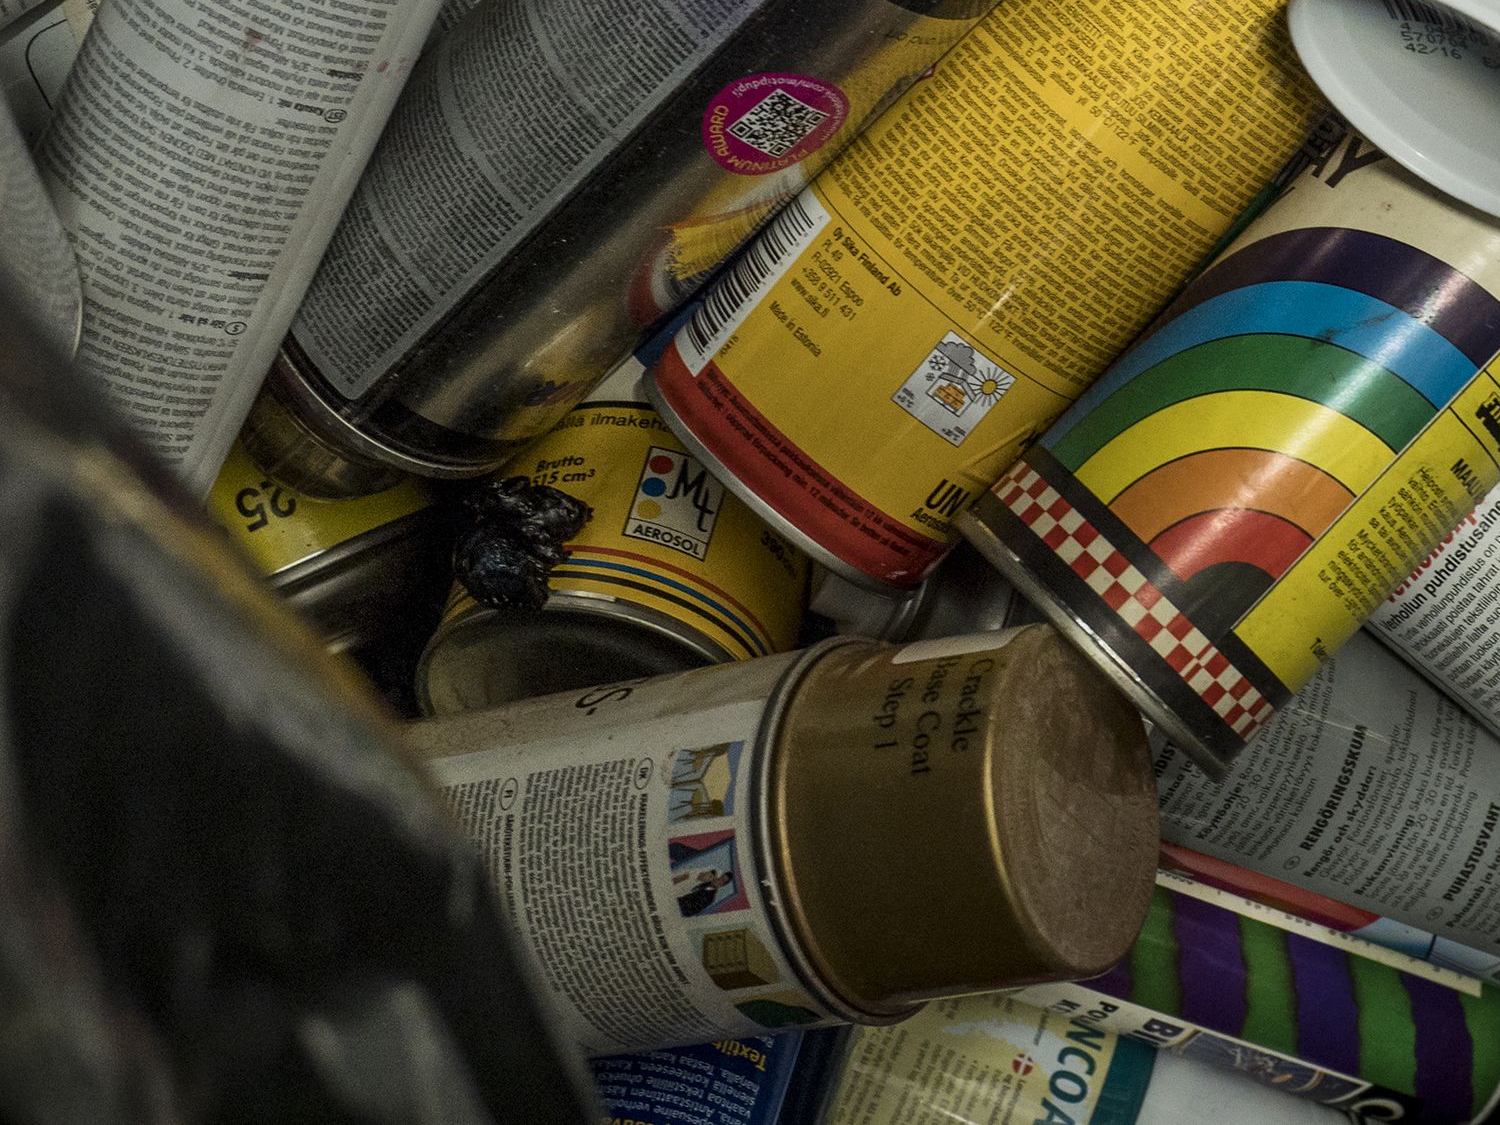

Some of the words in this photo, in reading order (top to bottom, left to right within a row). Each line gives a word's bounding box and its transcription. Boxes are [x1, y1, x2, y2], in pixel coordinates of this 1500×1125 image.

[841, 236, 859, 256] Sika
[857, 253, 888, 284] Finland
[887, 281, 902, 297] Ab
[793, 326, 822, 357] Estonia
[633, 524, 701, 555] AEROSOL
[1378, 590, 1429, 632] Verhoilun
[1443, 591, 1479, 625] poistaa
[1471, 562, 1500, 595] tahrat
[949, 658, 990, 753] Crackle
[1296, 722, 1369, 851] RENGÖRINGSSKUM
[1326, 821, 1348, 842] och
[1353, 812, 1417, 897] Bruksanvisning:
